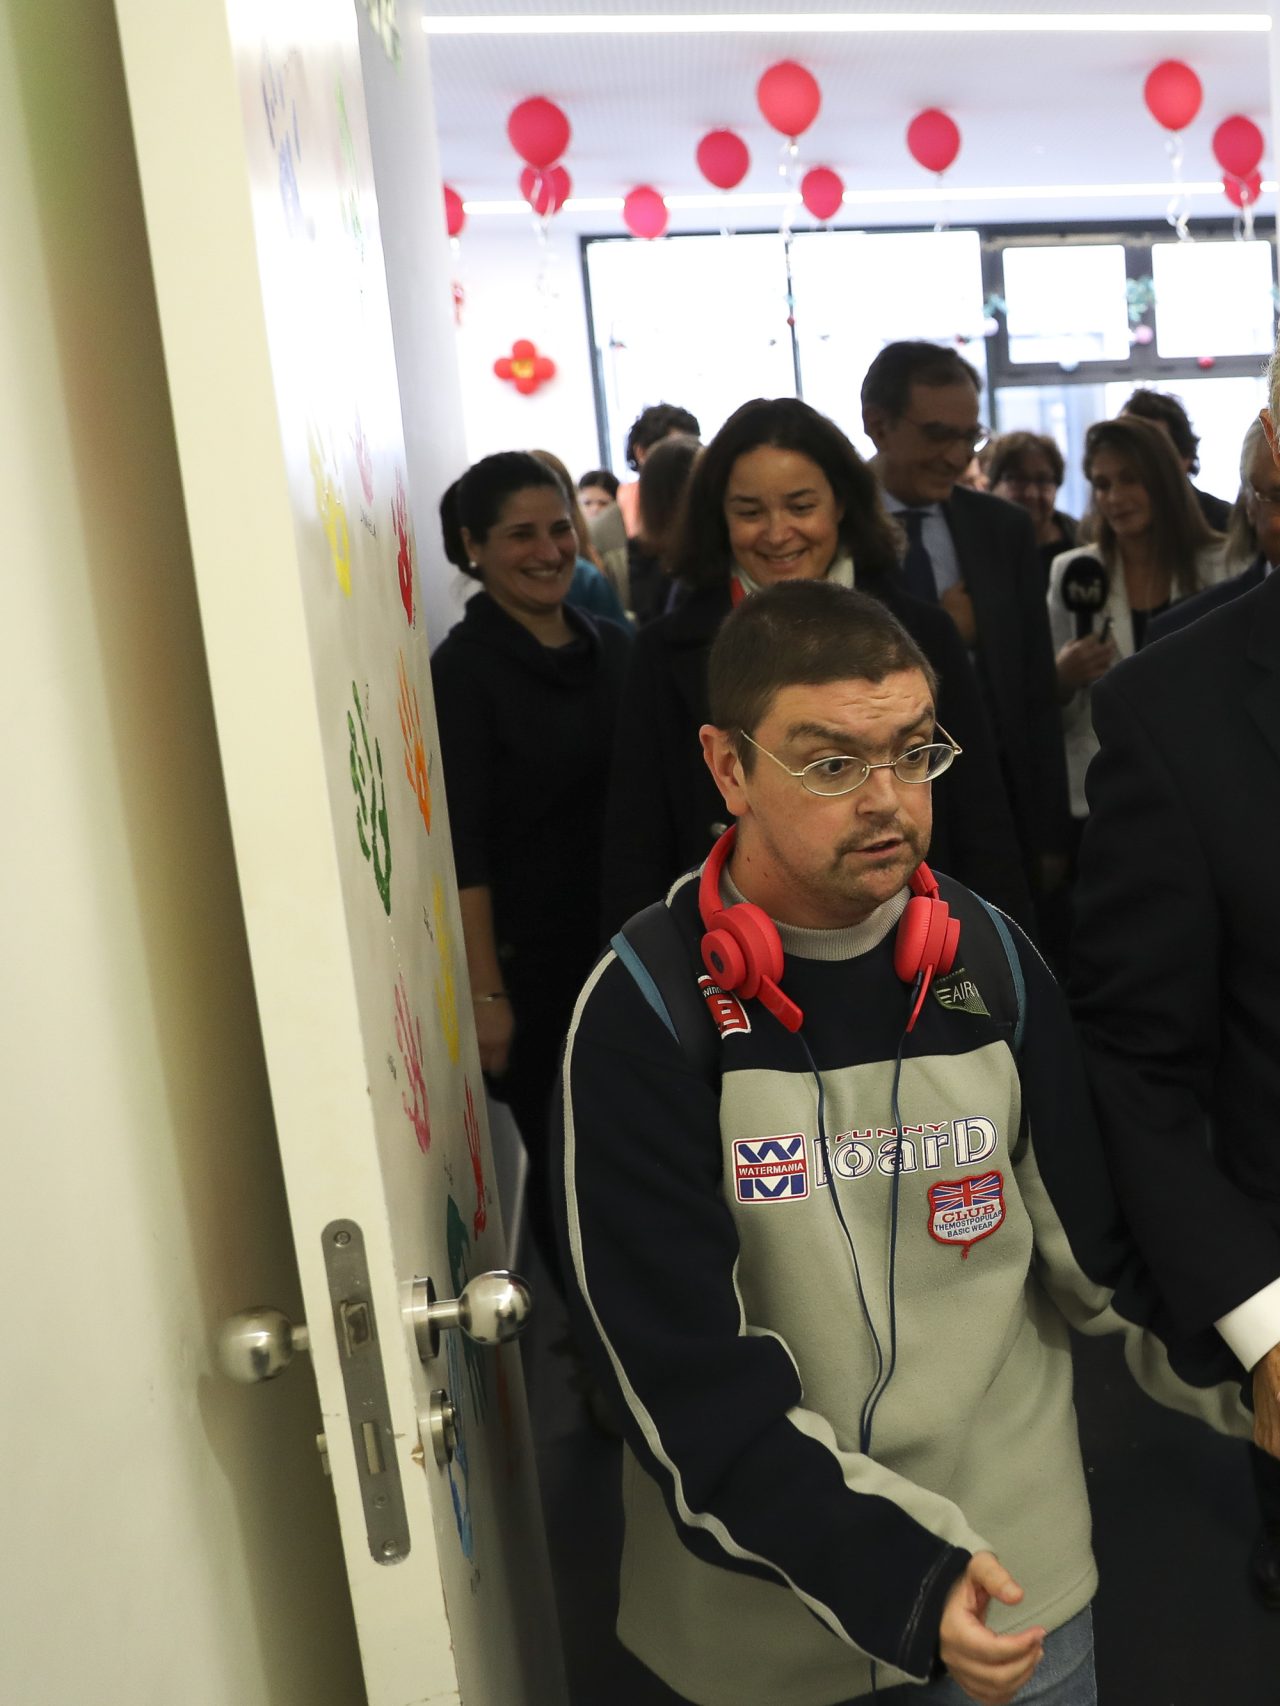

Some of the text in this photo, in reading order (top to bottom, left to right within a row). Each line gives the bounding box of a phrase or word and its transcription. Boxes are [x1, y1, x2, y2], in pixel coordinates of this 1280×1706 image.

[835, 1122, 948, 1143] FUNNY
[738, 1162, 804, 1176] WATERMANIA
[942, 1203, 995, 1223] CLUB
[947, 1221, 993, 1238] BASIC WEAR
